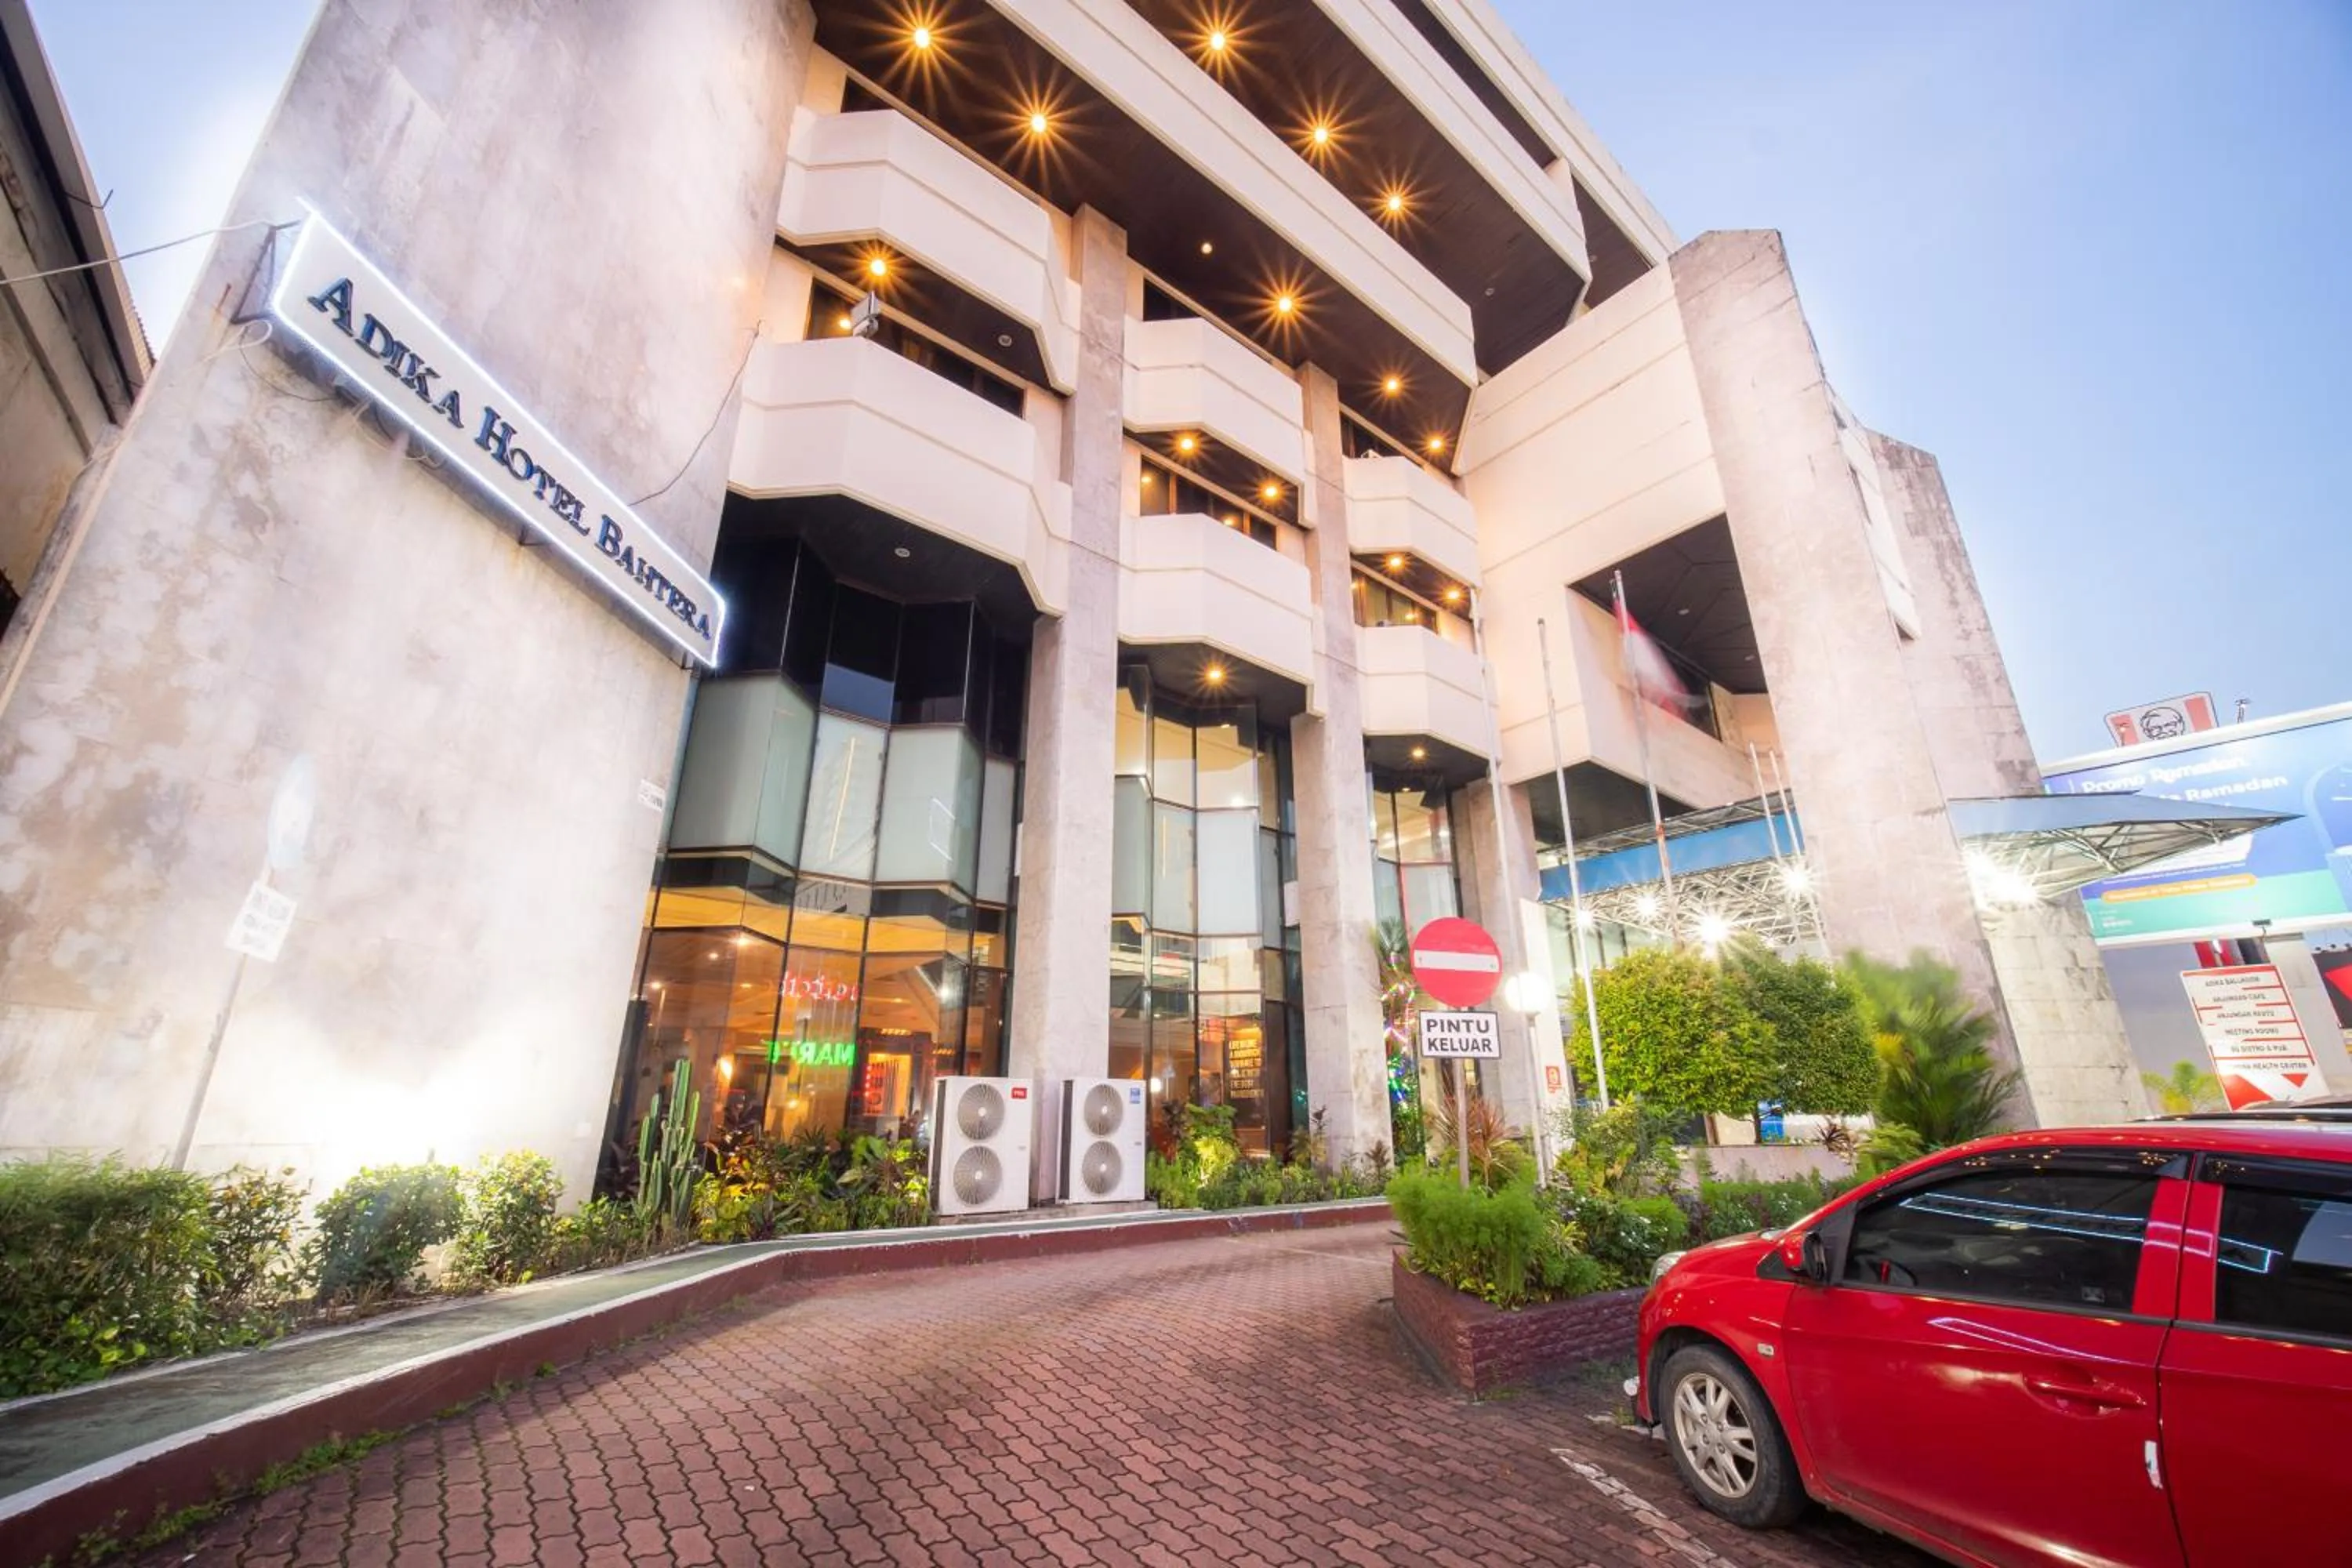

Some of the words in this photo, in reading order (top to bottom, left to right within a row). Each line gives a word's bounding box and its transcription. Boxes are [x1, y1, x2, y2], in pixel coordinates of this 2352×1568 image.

[307, 277, 465, 429] ADIKA
[474, 405, 590, 537] HOTEL
[594, 514, 711, 641] BAHTERA
[2184, 774, 2288, 802] Ramadan
[1425, 1018, 1490, 1034] PINTU
[1427, 1036, 1494, 1053] KELUAR
